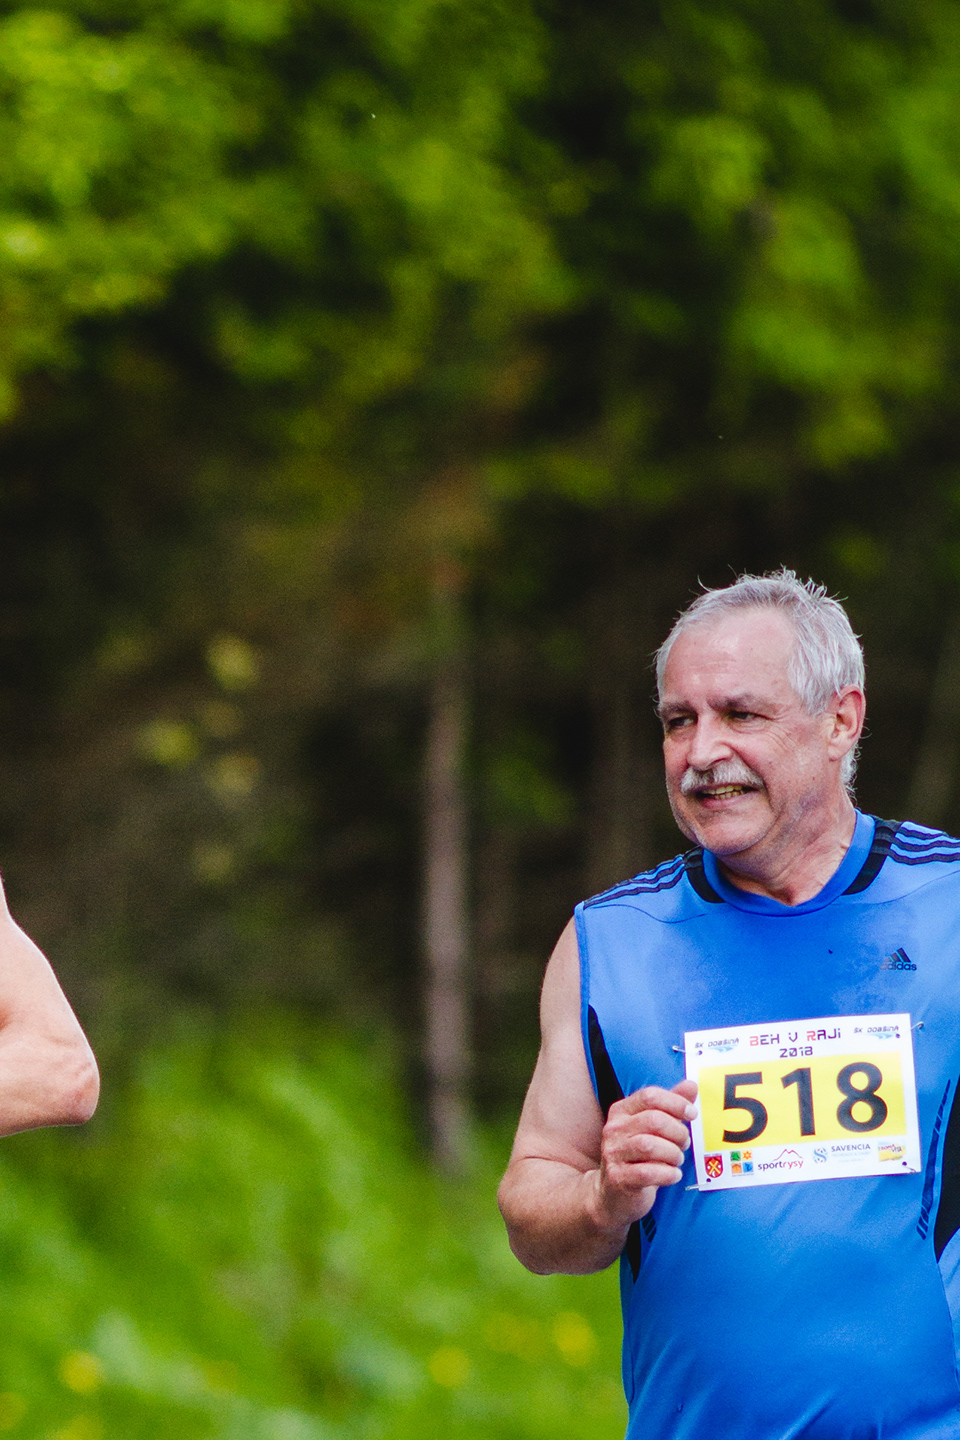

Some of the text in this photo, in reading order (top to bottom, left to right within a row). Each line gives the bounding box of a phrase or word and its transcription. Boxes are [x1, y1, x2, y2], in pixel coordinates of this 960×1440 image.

[749, 1033, 780, 1047] BEH
[779, 1045, 813, 1058] 2018
[722, 1061, 888, 1144] 518
[831, 1143, 871, 1152] SAVENCIA
[757, 1160, 804, 1172] sportrysy
